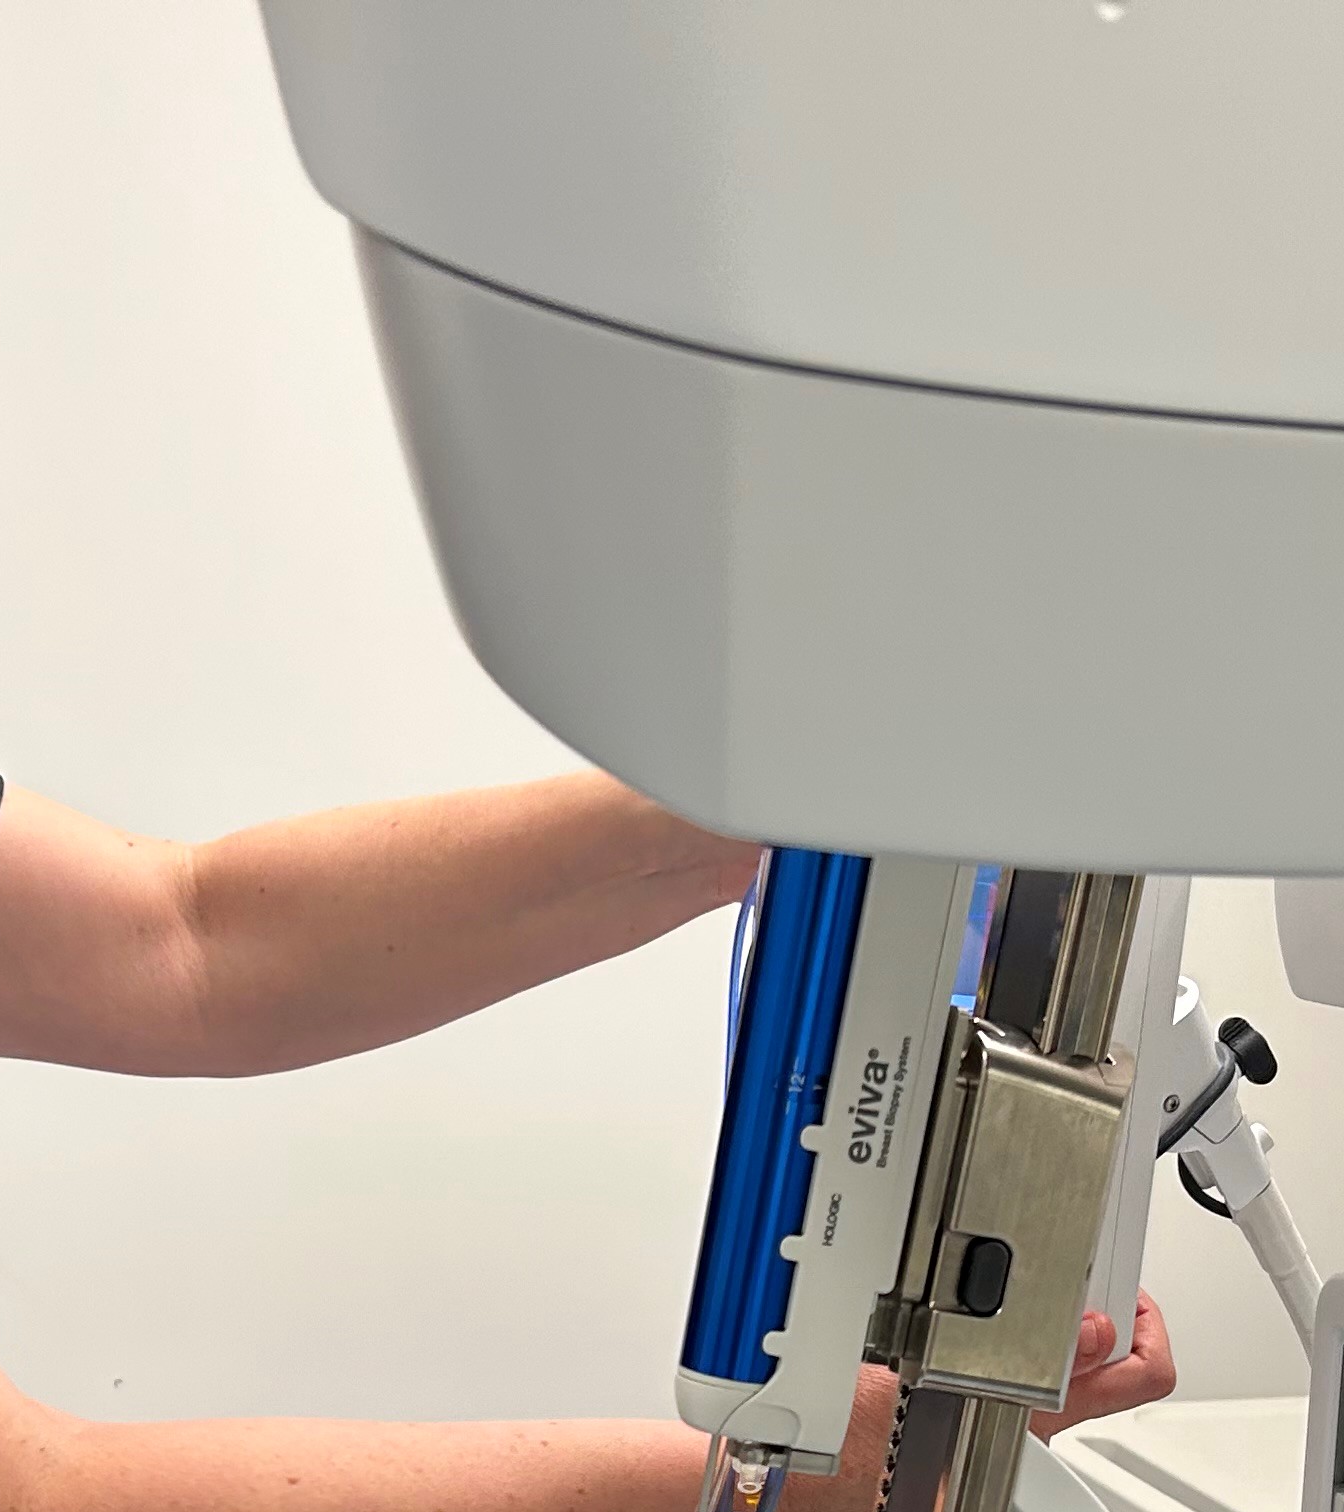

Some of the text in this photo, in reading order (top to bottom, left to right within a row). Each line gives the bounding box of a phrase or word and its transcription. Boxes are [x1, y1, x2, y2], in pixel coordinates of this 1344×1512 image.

[876, 1036, 912, 1168] Breast Biopsy System
[822, 1193, 843, 1247] HOLOGIC
